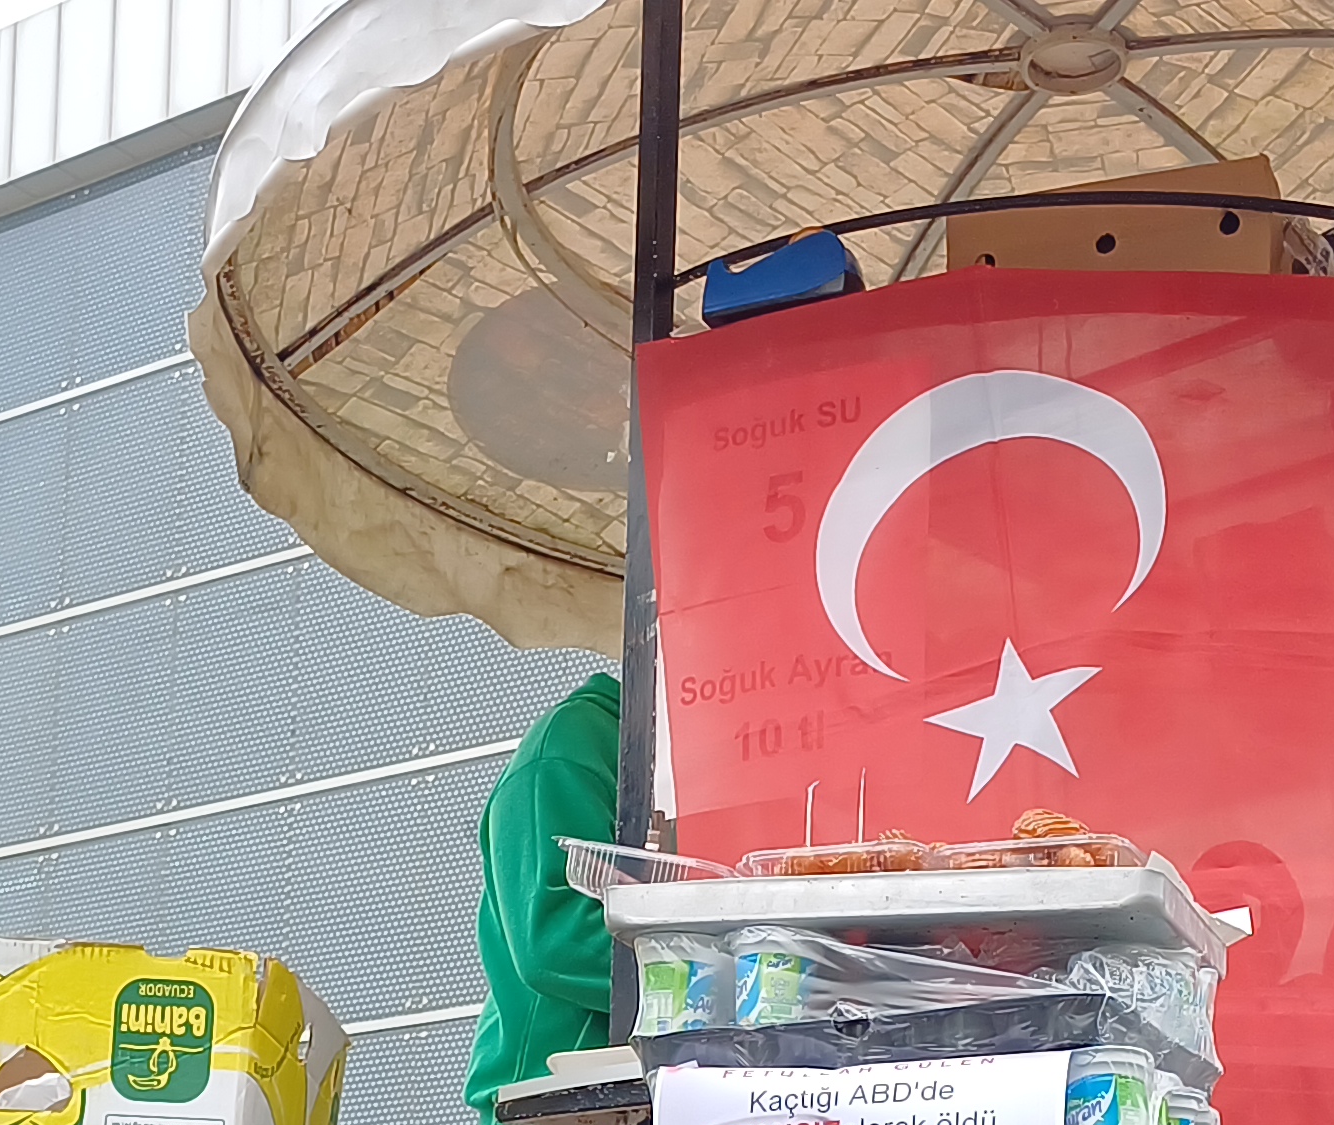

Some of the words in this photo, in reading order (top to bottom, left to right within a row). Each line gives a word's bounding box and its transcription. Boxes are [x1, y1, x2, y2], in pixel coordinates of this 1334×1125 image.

[817, 396, 861, 429] SU
[763, 470, 806, 543] 5
[680, 661, 776, 706] Soğuk
[734, 717, 782, 762] 10
[138, 983, 195, 998] ECUADOR
[120, 1003, 207, 1037] Banini
[749, 1086, 840, 1118] Kaçtığı
[848, 1080, 955, 1107] ABD'de
